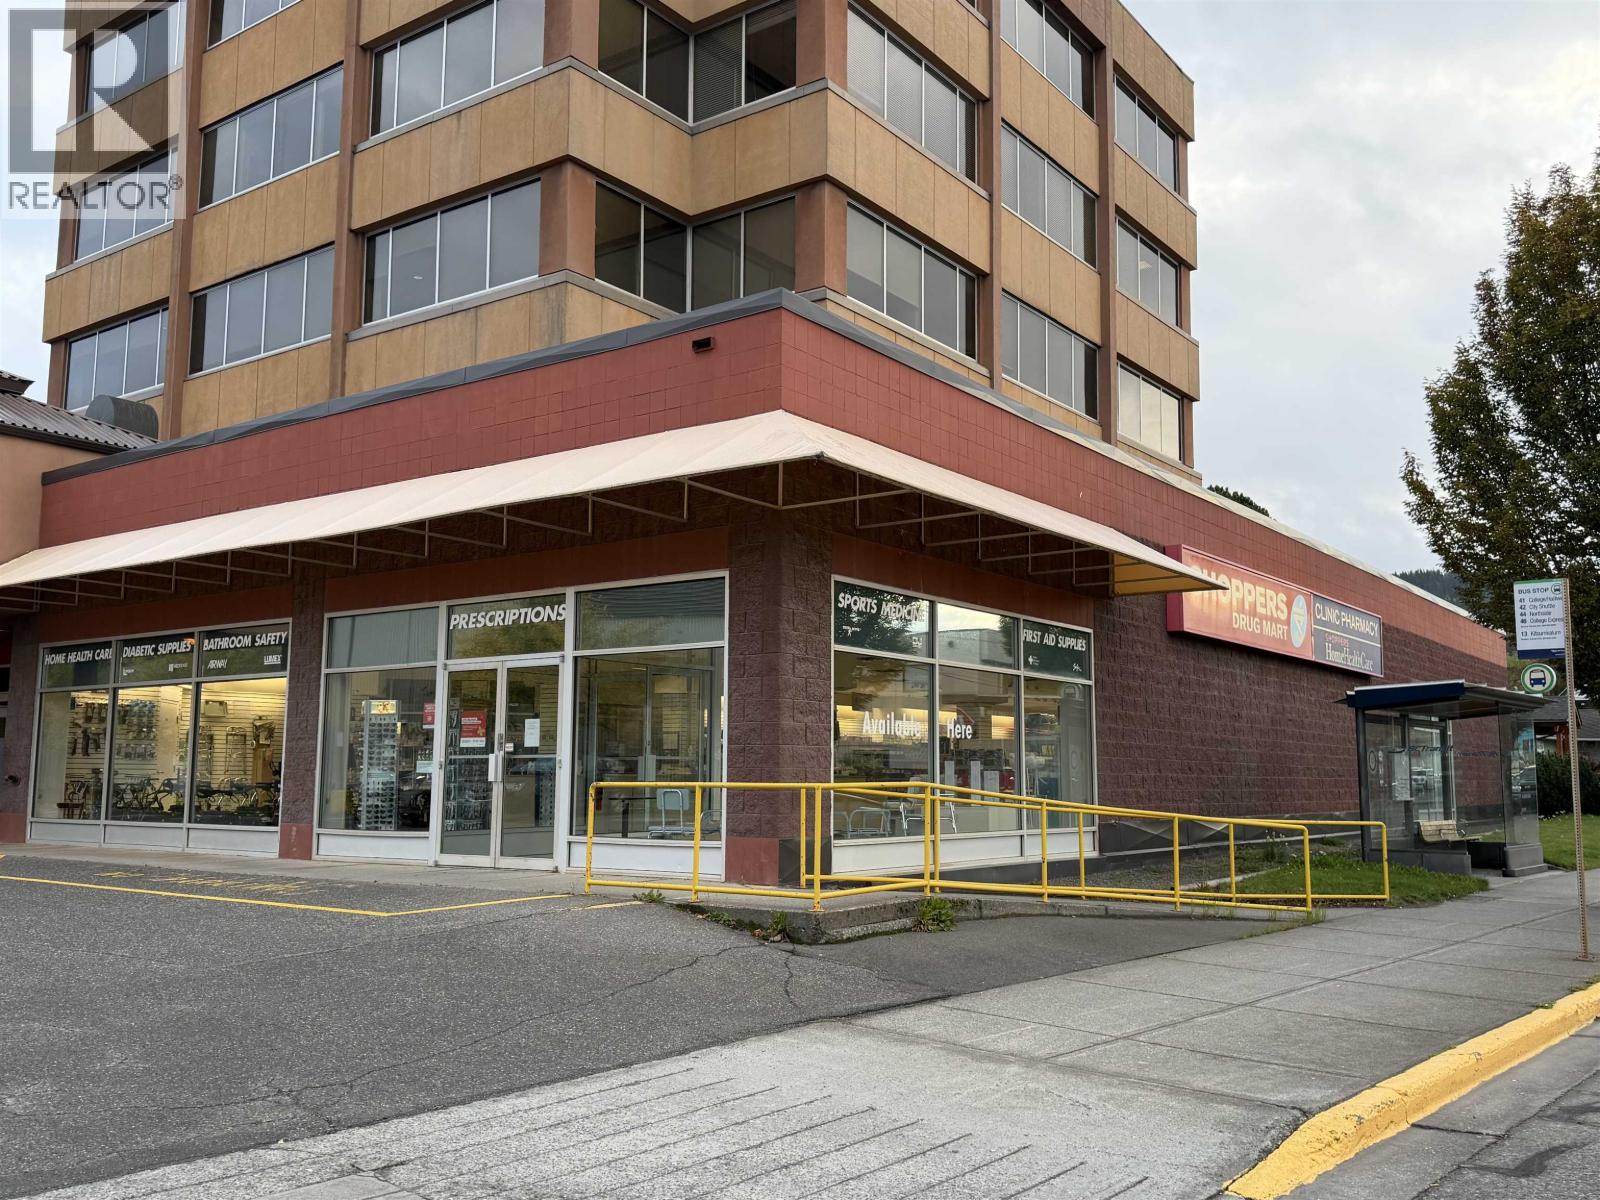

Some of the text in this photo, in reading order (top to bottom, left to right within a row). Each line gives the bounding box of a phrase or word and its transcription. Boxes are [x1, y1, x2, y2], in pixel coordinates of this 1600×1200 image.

[837, 592, 878, 614] SPORTS
[449, 604, 567, 630] PRESCRIPTIONS
[1232, 612, 1288, 640] DRUG MART
[1315, 603, 1379, 637] CLINIC PHARMACY
[122, 640, 192, 658] DIABETIC SUPPLIES
[203, 631, 288, 651] BATHROOM SAFETY
[1023, 629, 1087, 651] FIRST AID SUPPLIES
[44, 648, 113, 665] HOME HEALTH CARE
[863, 711, 973, 739] Available Here
